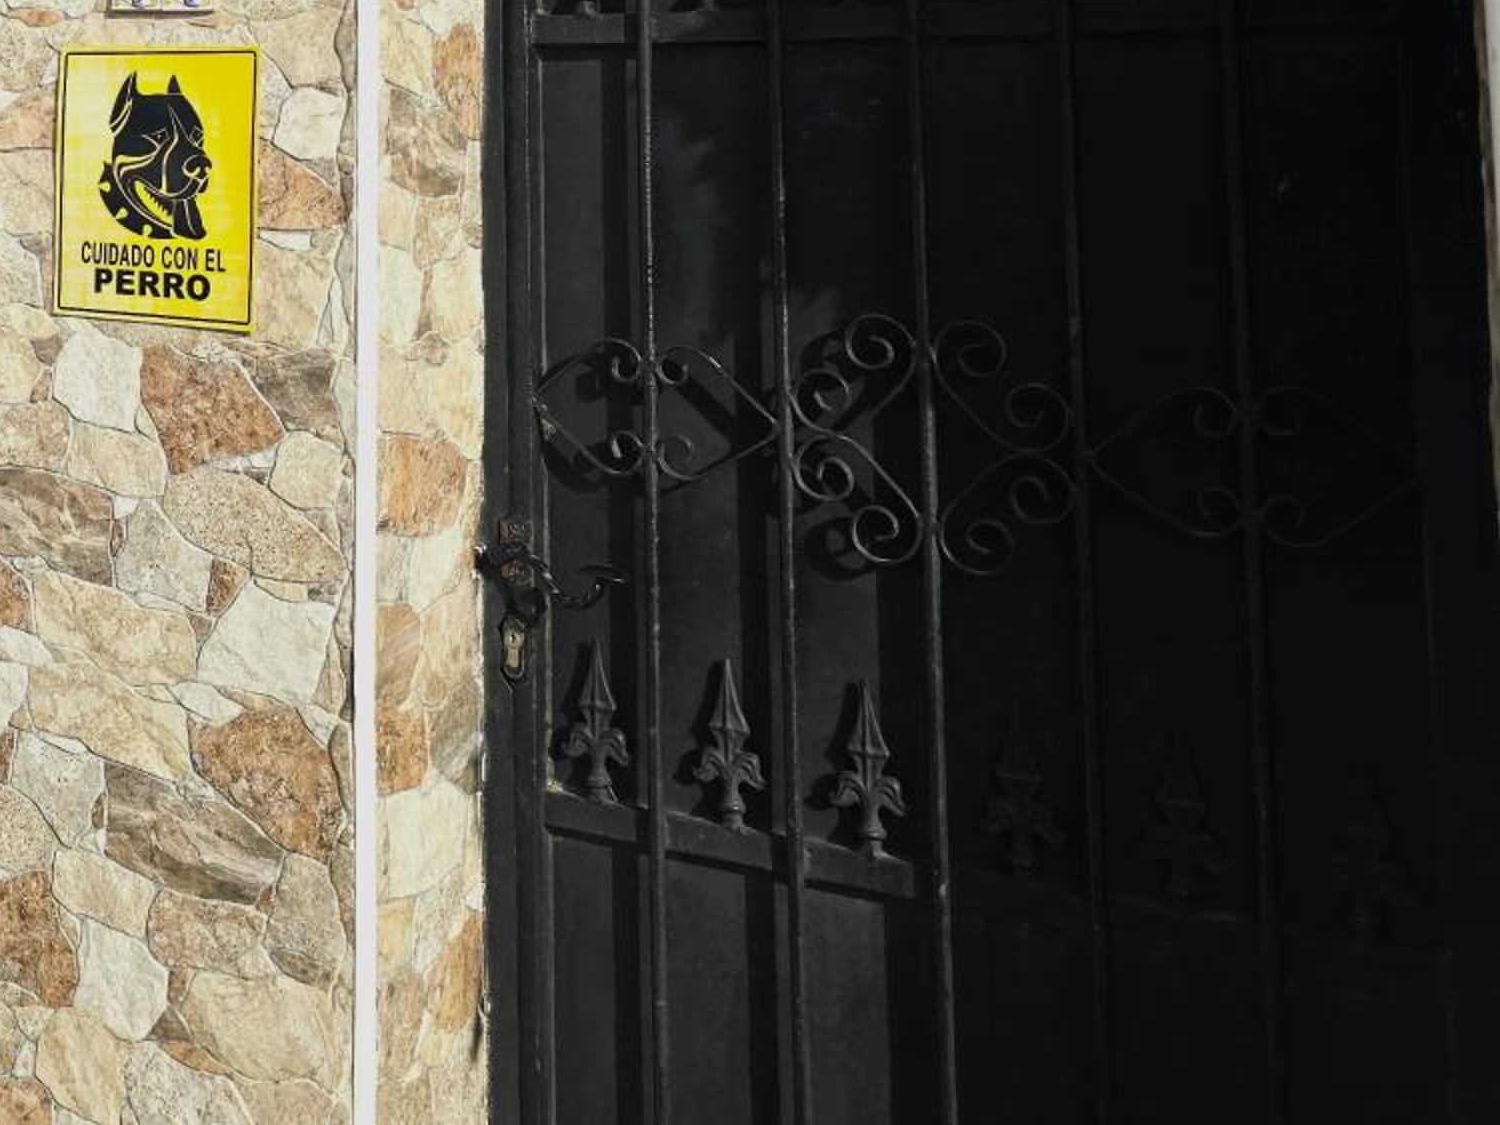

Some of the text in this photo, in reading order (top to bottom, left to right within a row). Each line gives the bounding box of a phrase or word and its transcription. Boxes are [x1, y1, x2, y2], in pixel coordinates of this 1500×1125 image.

[81, 240, 226, 272] CUIDADO CON EL
[94, 268, 211, 301] PERRO
